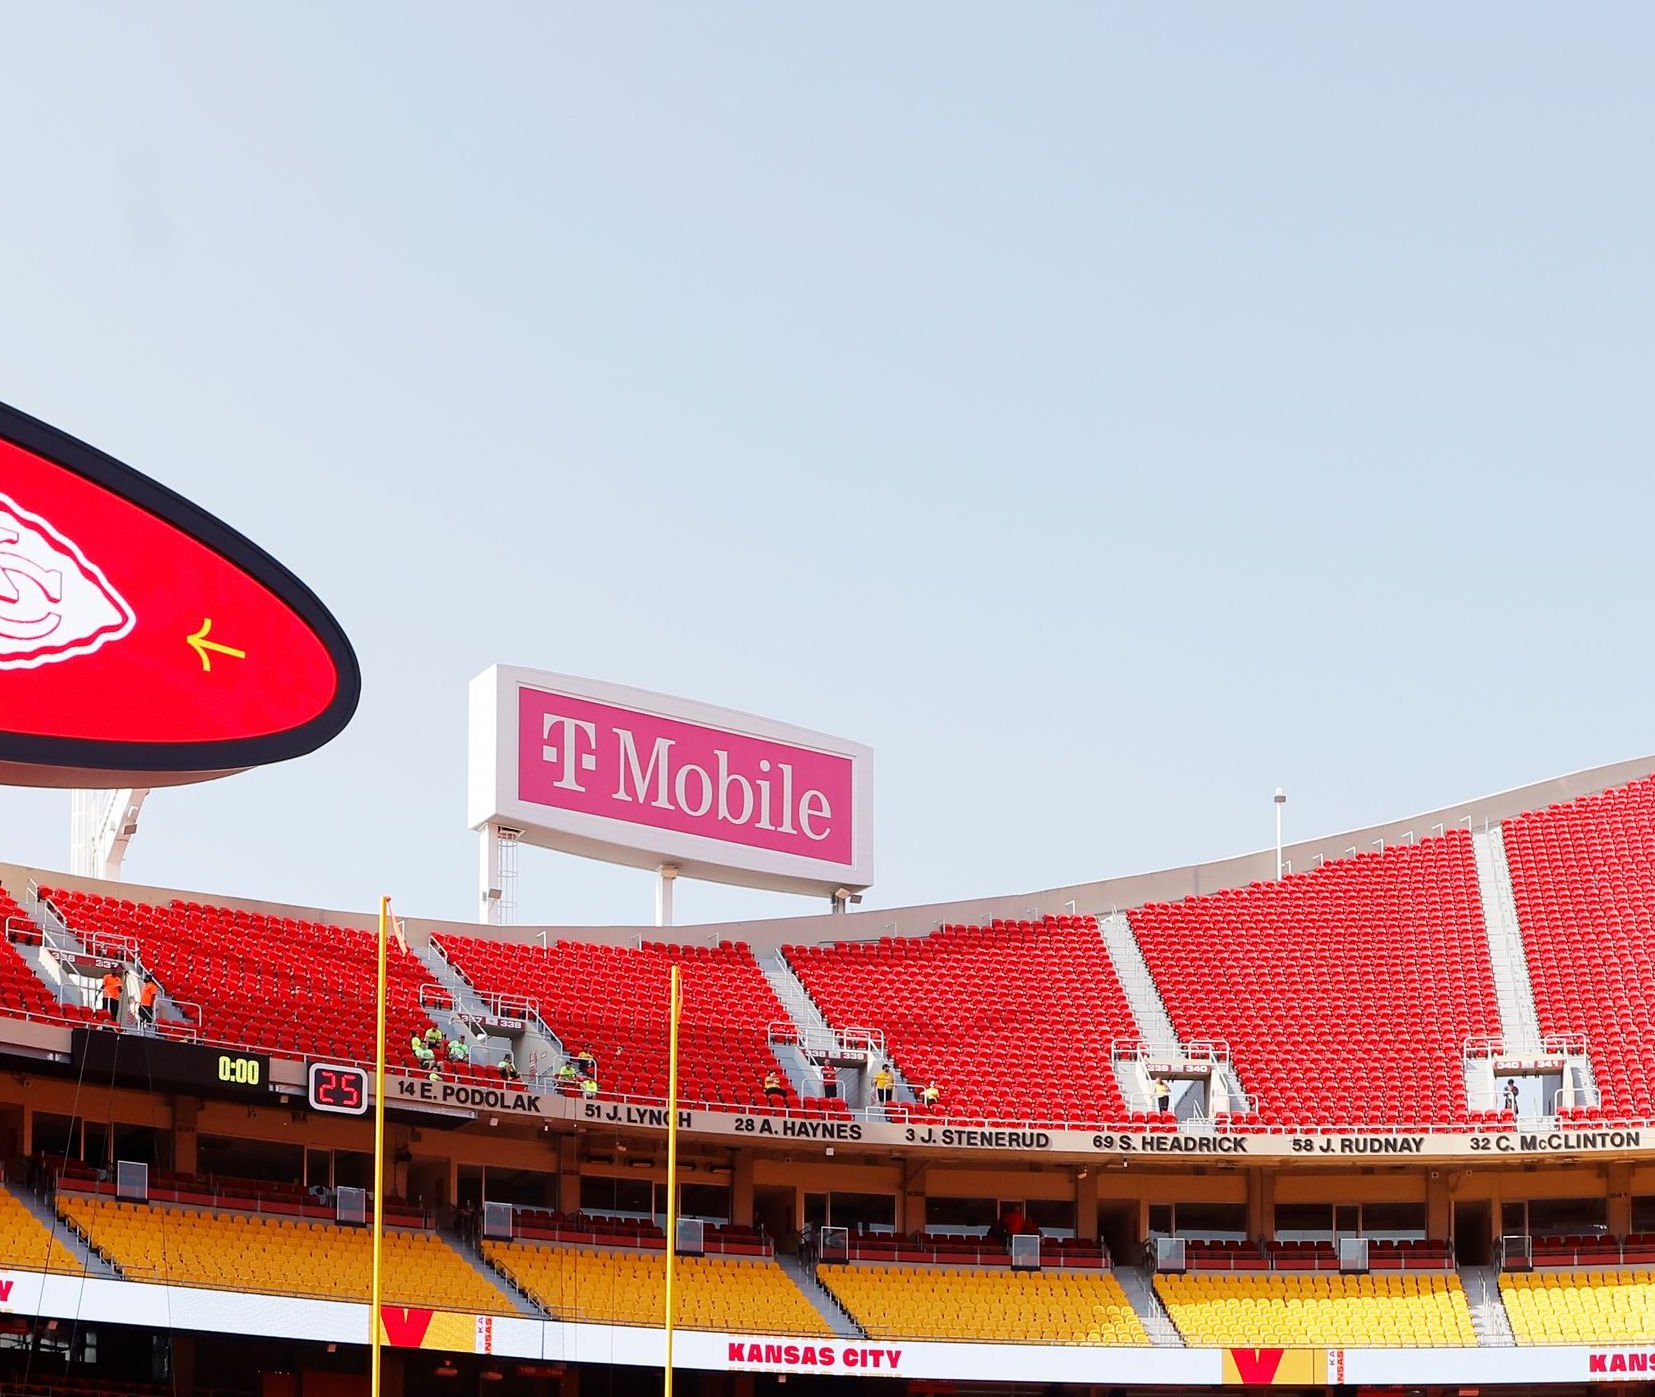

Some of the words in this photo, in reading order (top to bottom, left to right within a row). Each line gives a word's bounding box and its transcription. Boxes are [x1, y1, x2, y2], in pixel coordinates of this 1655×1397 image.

[96, 960, 118, 968] 337
[500, 1020, 521, 1028] 338
[218, 1055, 260, 1085] 0:00
[319, 1071, 359, 1106] 25
[398, 1080, 417, 1097] 14
[420, 1083, 438, 1101] E.
[443, 1085, 541, 1113] PODOLAK
[584, 1104, 602, 1117] 51
[606, 1105, 622, 1122] J.
[734, 1118, 756, 1132] 28
[758, 1118, 779, 1135] A.
[784, 1119, 862, 1141] HAYNES
[905, 1128, 915, 1142] 3
[920, 1128, 937, 1144] J.
[941, 1128, 1050, 1149] STENERUD
[1092, 1135, 1114, 1150] 69
[1118, 1135, 1138, 1151] S.
[1141, 1135, 1248, 1153] HEADRICK
[1291, 1138, 1317, 1153] 58
[1319, 1137, 1336, 1154] J.
[1340, 1137, 1425, 1154] RUDNAY
[1469, 1137, 1492, 1151] 32
[1495, 1136, 1515, 1152] C.
[1520, 1131, 1641, 1151] McCLINTON
[727, 1342, 836, 1367] KANSAS
[843, 1347, 902, 1369] CITY
